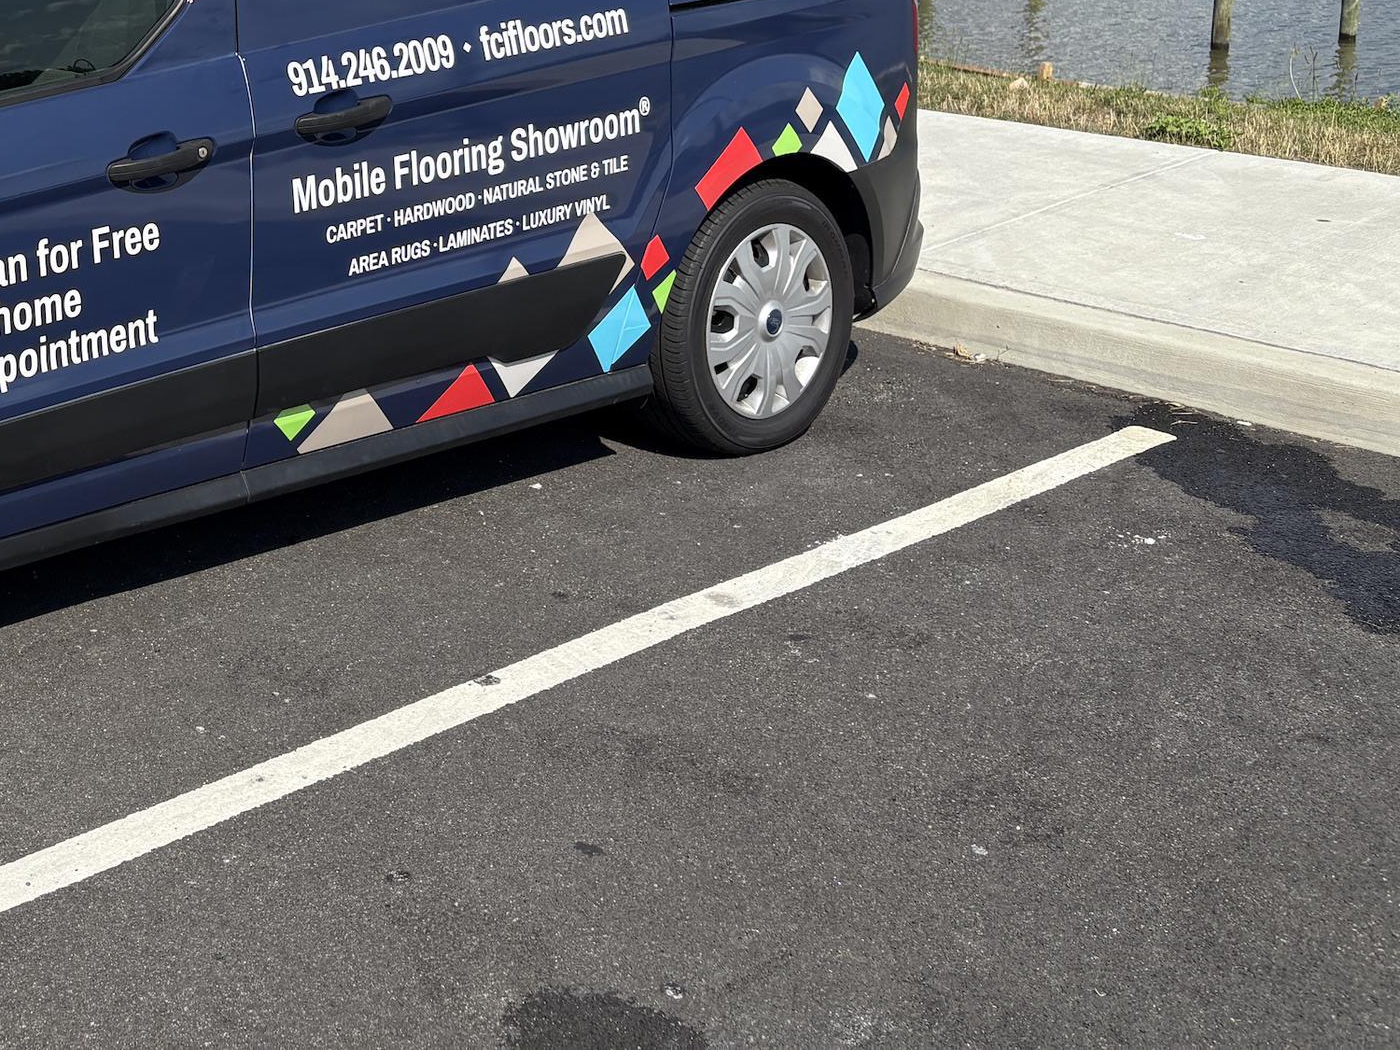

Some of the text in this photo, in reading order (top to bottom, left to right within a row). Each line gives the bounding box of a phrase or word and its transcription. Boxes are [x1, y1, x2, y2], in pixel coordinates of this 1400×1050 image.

[287, 8, 629, 97] 914.246.2009 fcifloors.com
[291, 160, 386, 214] Mobile
[393, 135, 505, 190] Flooring
[325, 154, 629, 244] CARPET HARDWOOD NATURAL STONE & TILE
[36, 237, 83, 277] for
[91, 222, 160, 264] Free
[348, 194, 611, 277] AREA RUGS LAMINATES LUXURY VINYL
